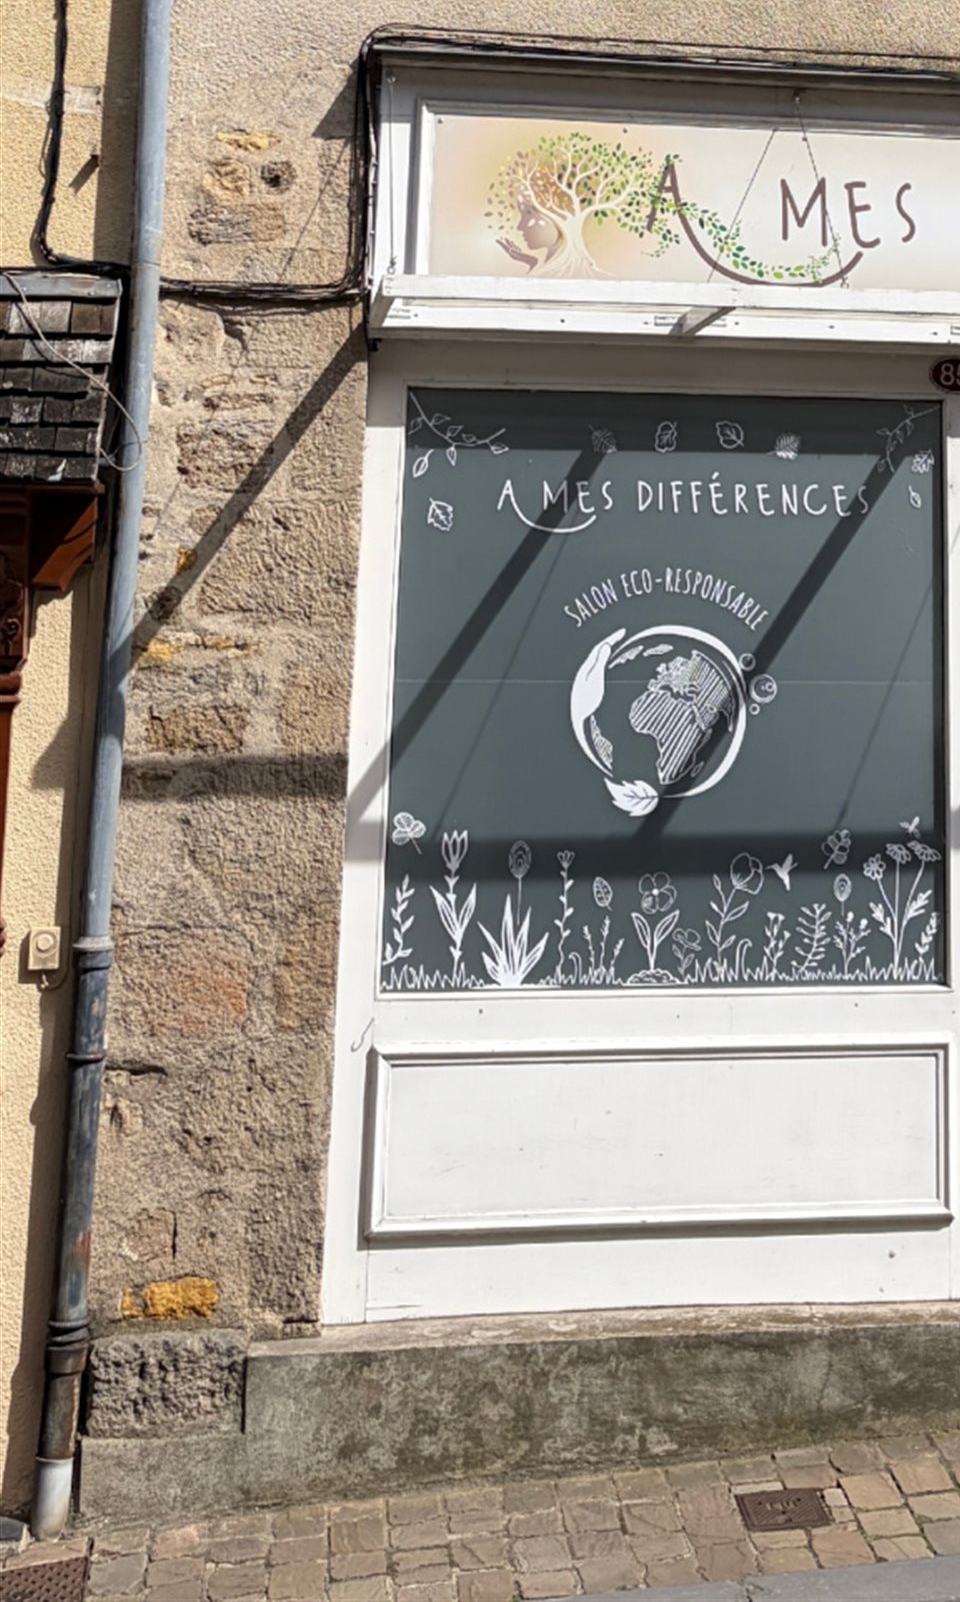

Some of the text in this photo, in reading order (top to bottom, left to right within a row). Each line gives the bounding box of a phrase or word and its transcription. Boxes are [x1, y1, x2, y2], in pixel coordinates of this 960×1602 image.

[779, 176, 917, 250] MES
[542, 479, 614, 515] MES
[637, 472, 870, 518] DIFFÉRENCES
[564, 566, 769, 631] SALON ECO-RESPONSABLE
